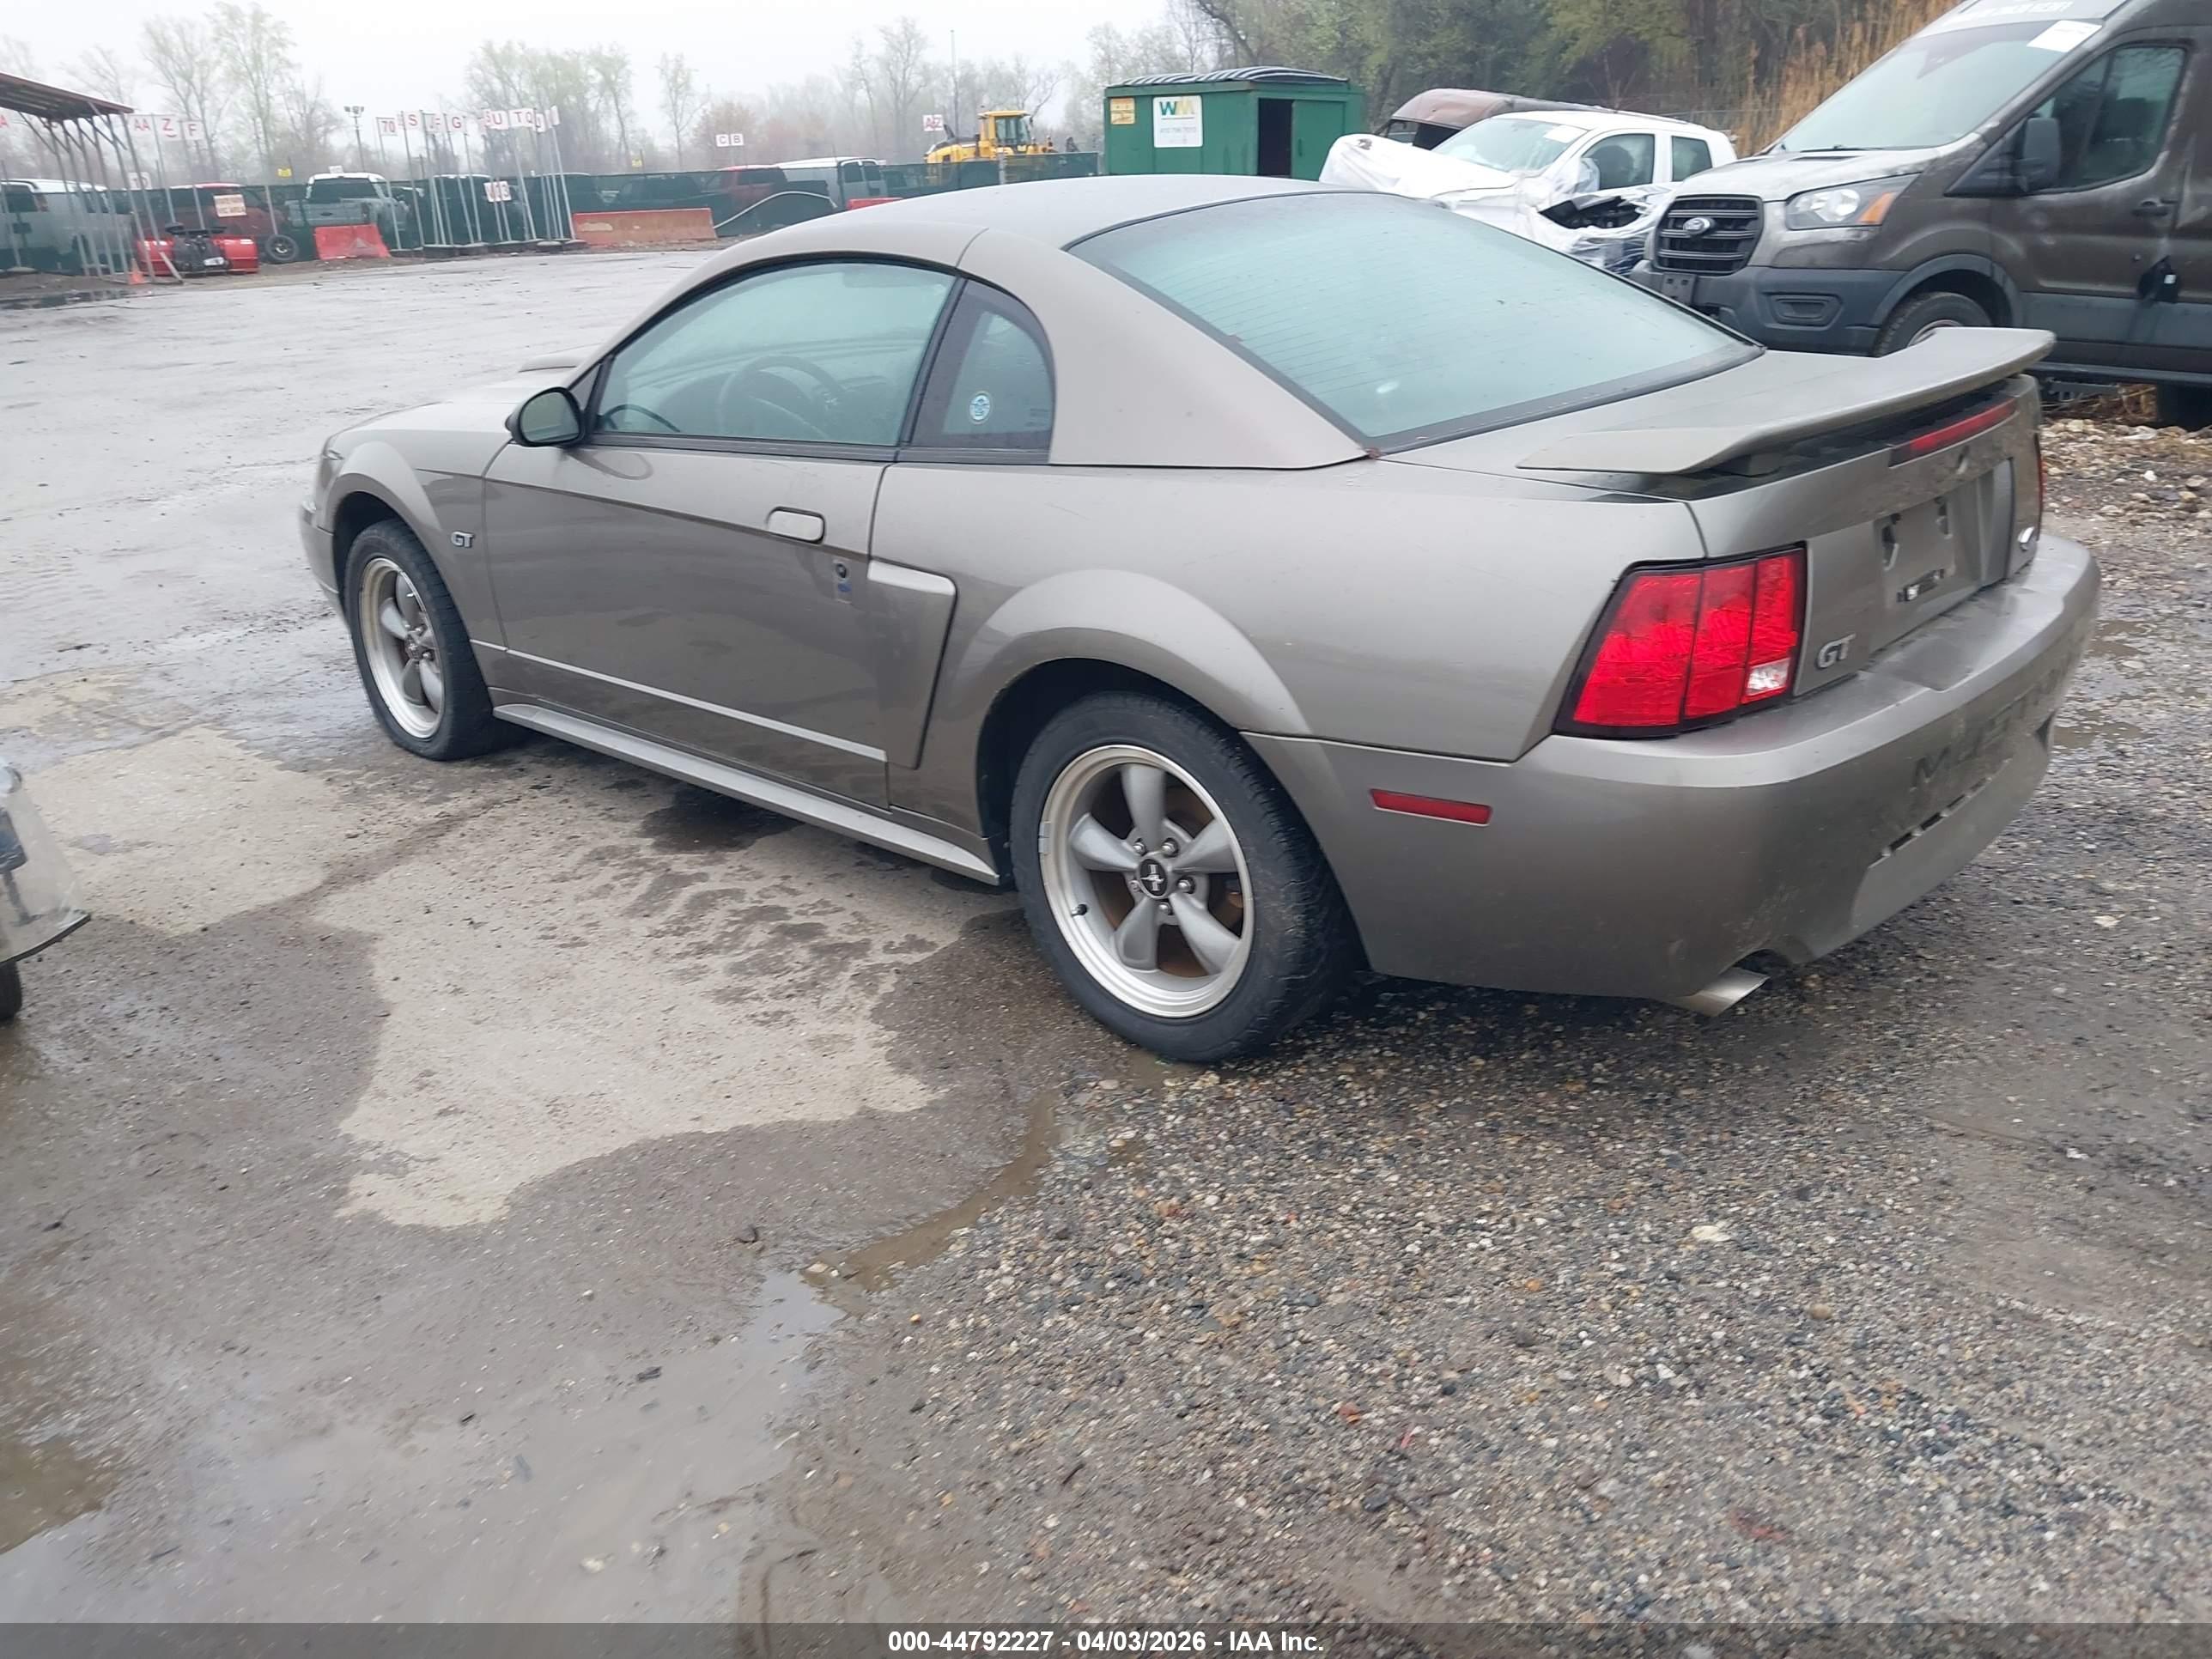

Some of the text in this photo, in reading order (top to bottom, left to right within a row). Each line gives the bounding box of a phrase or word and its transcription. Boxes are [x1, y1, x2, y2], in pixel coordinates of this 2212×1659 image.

[380, 119, 397, 133] 70
[408, 113, 418, 127] S
[452, 116, 462, 130] G
[187, 123, 198, 137] F
[451, 530, 475, 548] GT
[1817, 632, 1857, 669] GT
